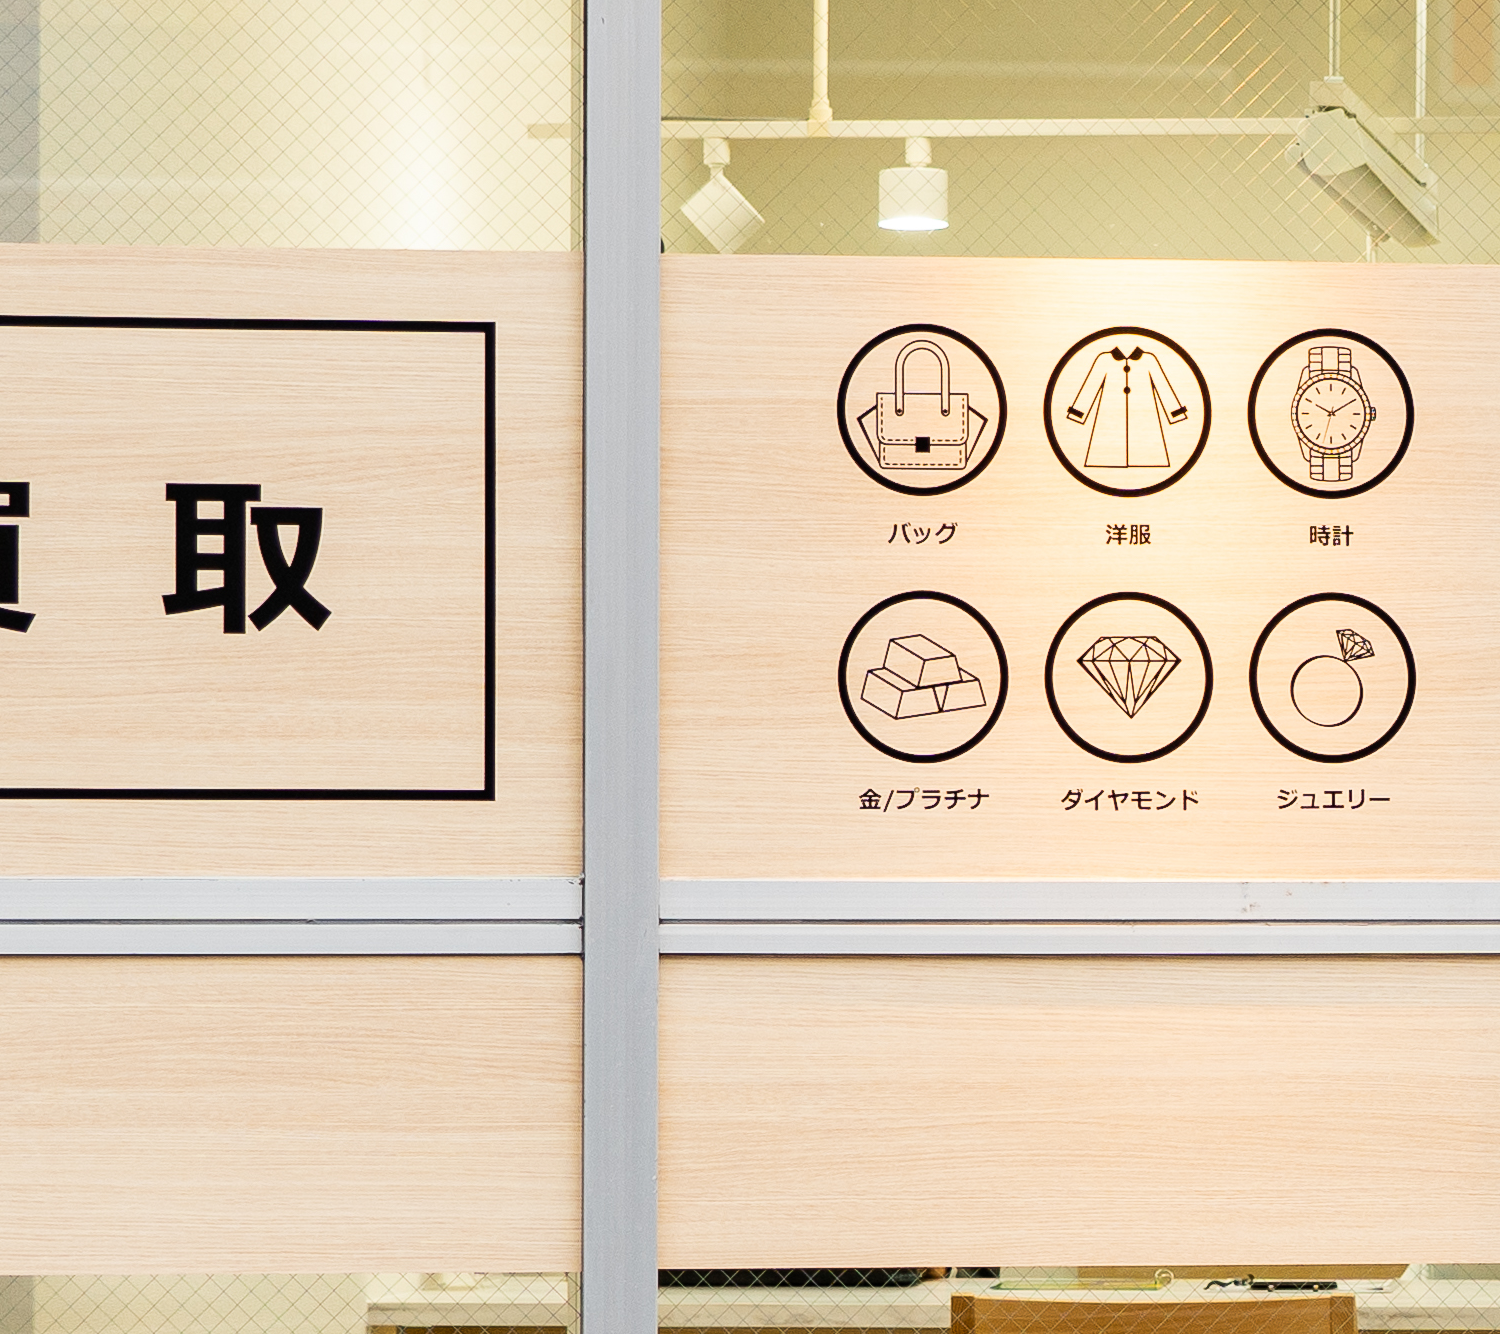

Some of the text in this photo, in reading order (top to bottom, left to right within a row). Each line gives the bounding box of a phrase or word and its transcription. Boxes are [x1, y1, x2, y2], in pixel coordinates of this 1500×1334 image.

[887, 521, 959, 546] バッグ
[1105, 522, 1152, 546] 洋服
[1308, 523, 1355, 548] 時計
[858, 786, 991, 812] 金/プラチナ
[1060, 787, 1200, 812] ダイヤモンド
[1276, 787, 1391, 811] ジュエリー
